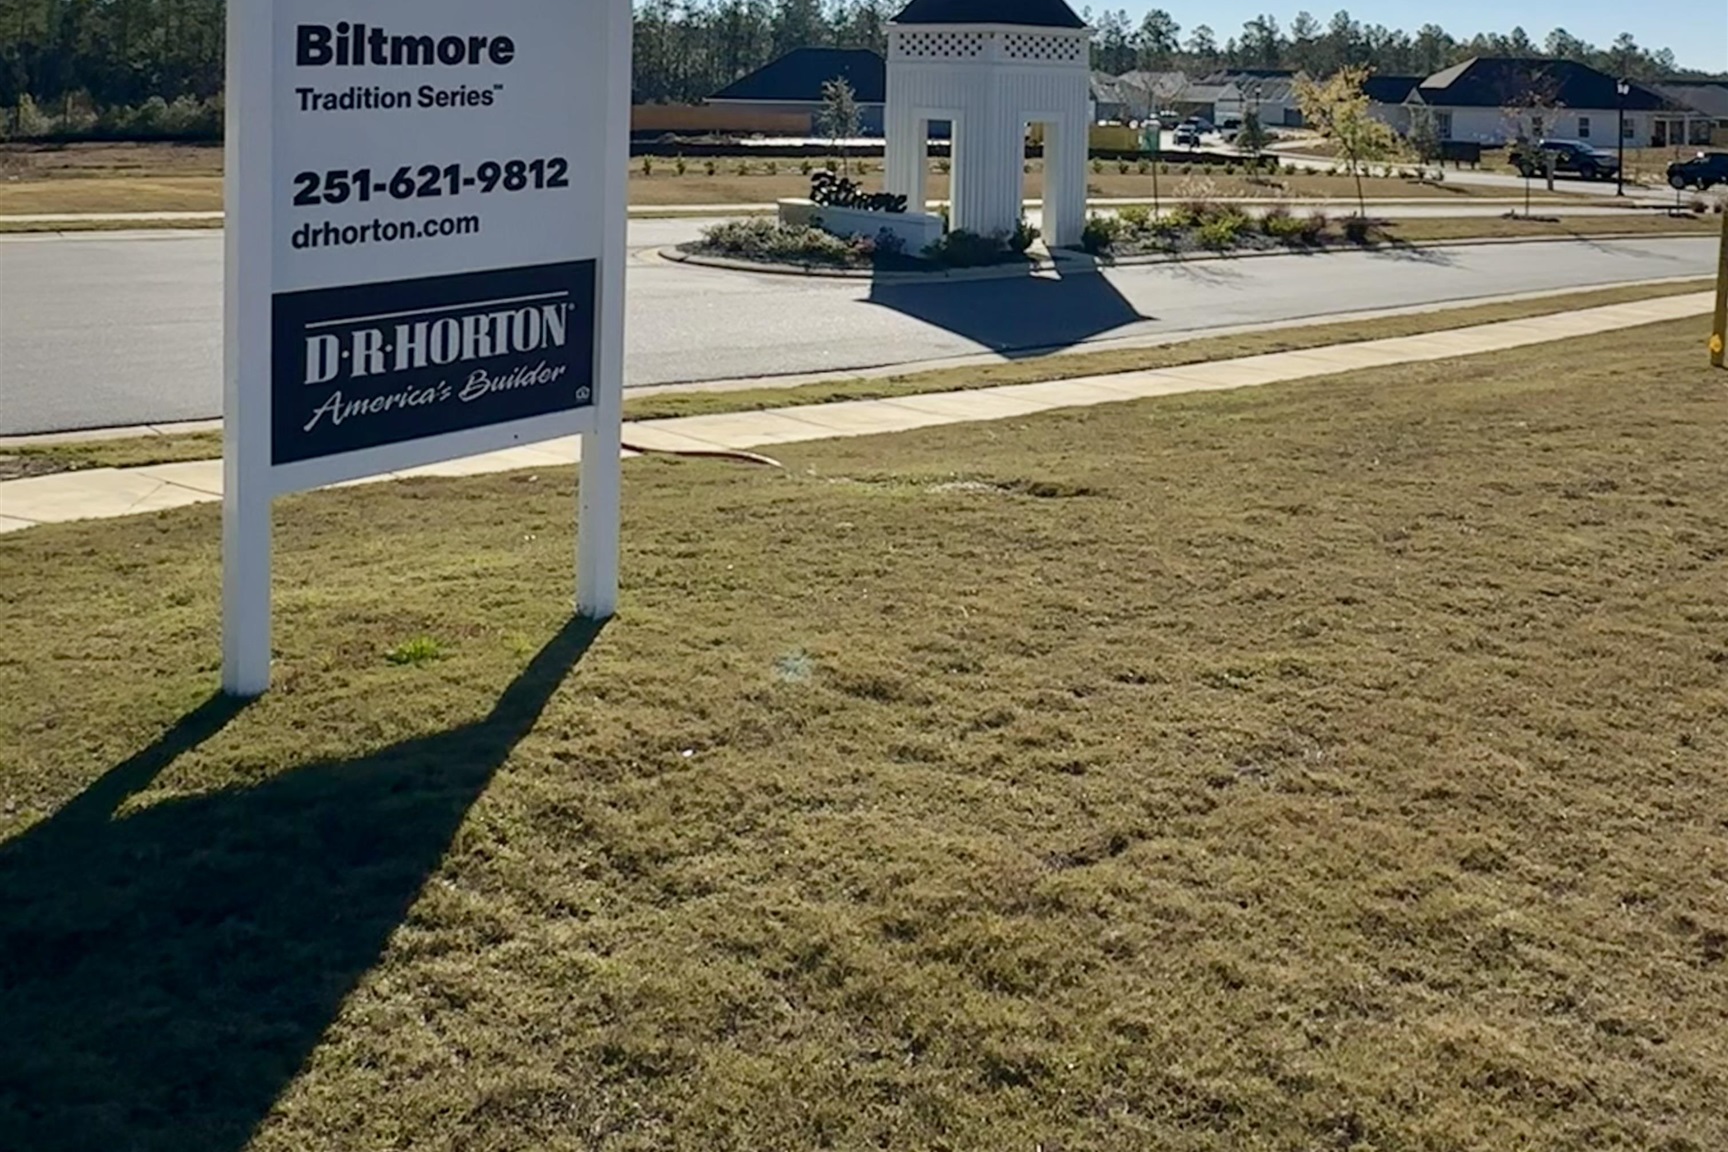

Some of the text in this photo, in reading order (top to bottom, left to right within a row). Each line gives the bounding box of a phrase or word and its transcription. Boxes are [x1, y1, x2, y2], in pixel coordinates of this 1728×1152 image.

[296, 22, 515, 67] Biltmore
[295, 86, 412, 111] Tradition
[293, 157, 569, 206] 251-621-9812
[291, 215, 480, 250] drhorton.com
[303, 360, 566, 432] America's Builder
